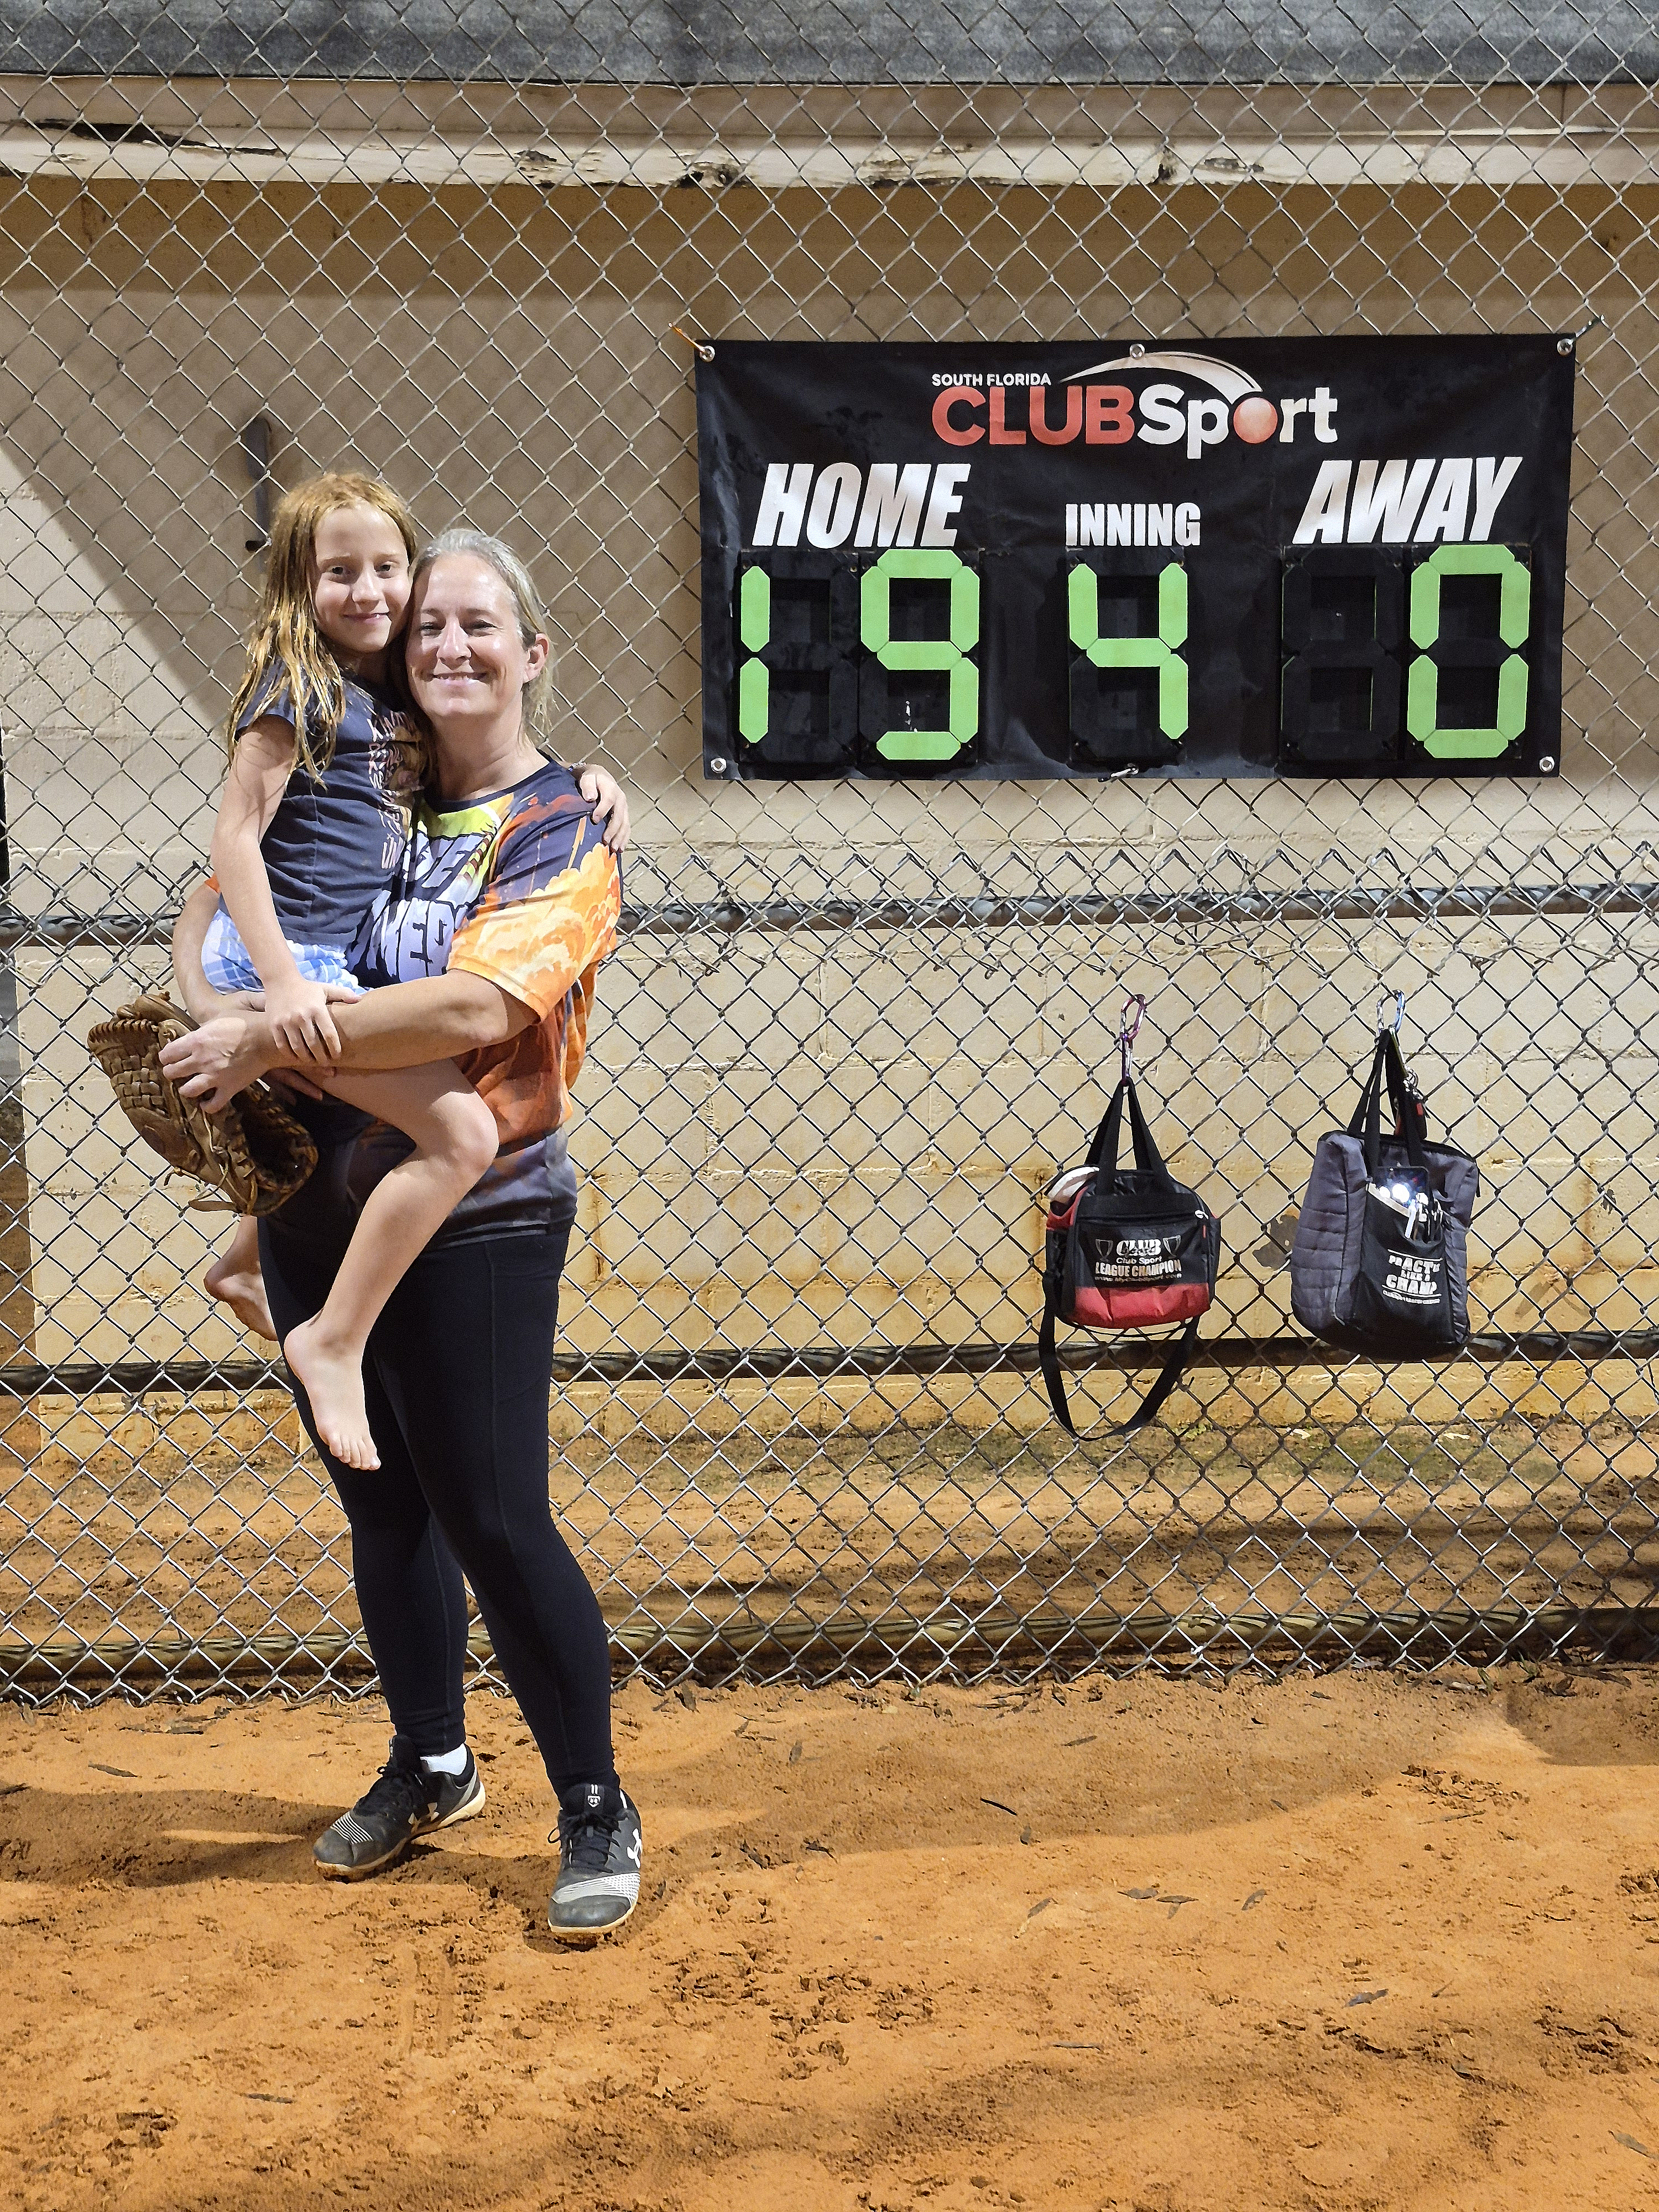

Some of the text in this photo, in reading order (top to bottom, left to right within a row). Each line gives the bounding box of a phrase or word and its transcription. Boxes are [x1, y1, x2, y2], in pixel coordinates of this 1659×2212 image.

[932, 373, 1052, 387] SOUTH FLORIDA
[752, 462, 972, 548] HOME
[1292, 456, 1524, 545] AWAY
[1065, 502, 1201, 547] INNING
[739, 549, 980, 760] 19
[1068, 563, 1188, 739] 4
[1407, 544, 1531, 759] 0
[1116, 1239, 1162, 1256] CLUB
[1139, 1255, 1162, 1265] Sport
[1095, 1259, 1182, 1277] LEAGUE CHAMPION
[1386, 1274, 1437, 1295] CHAMP
[1401, 1270, 1423, 1281] LIKE
